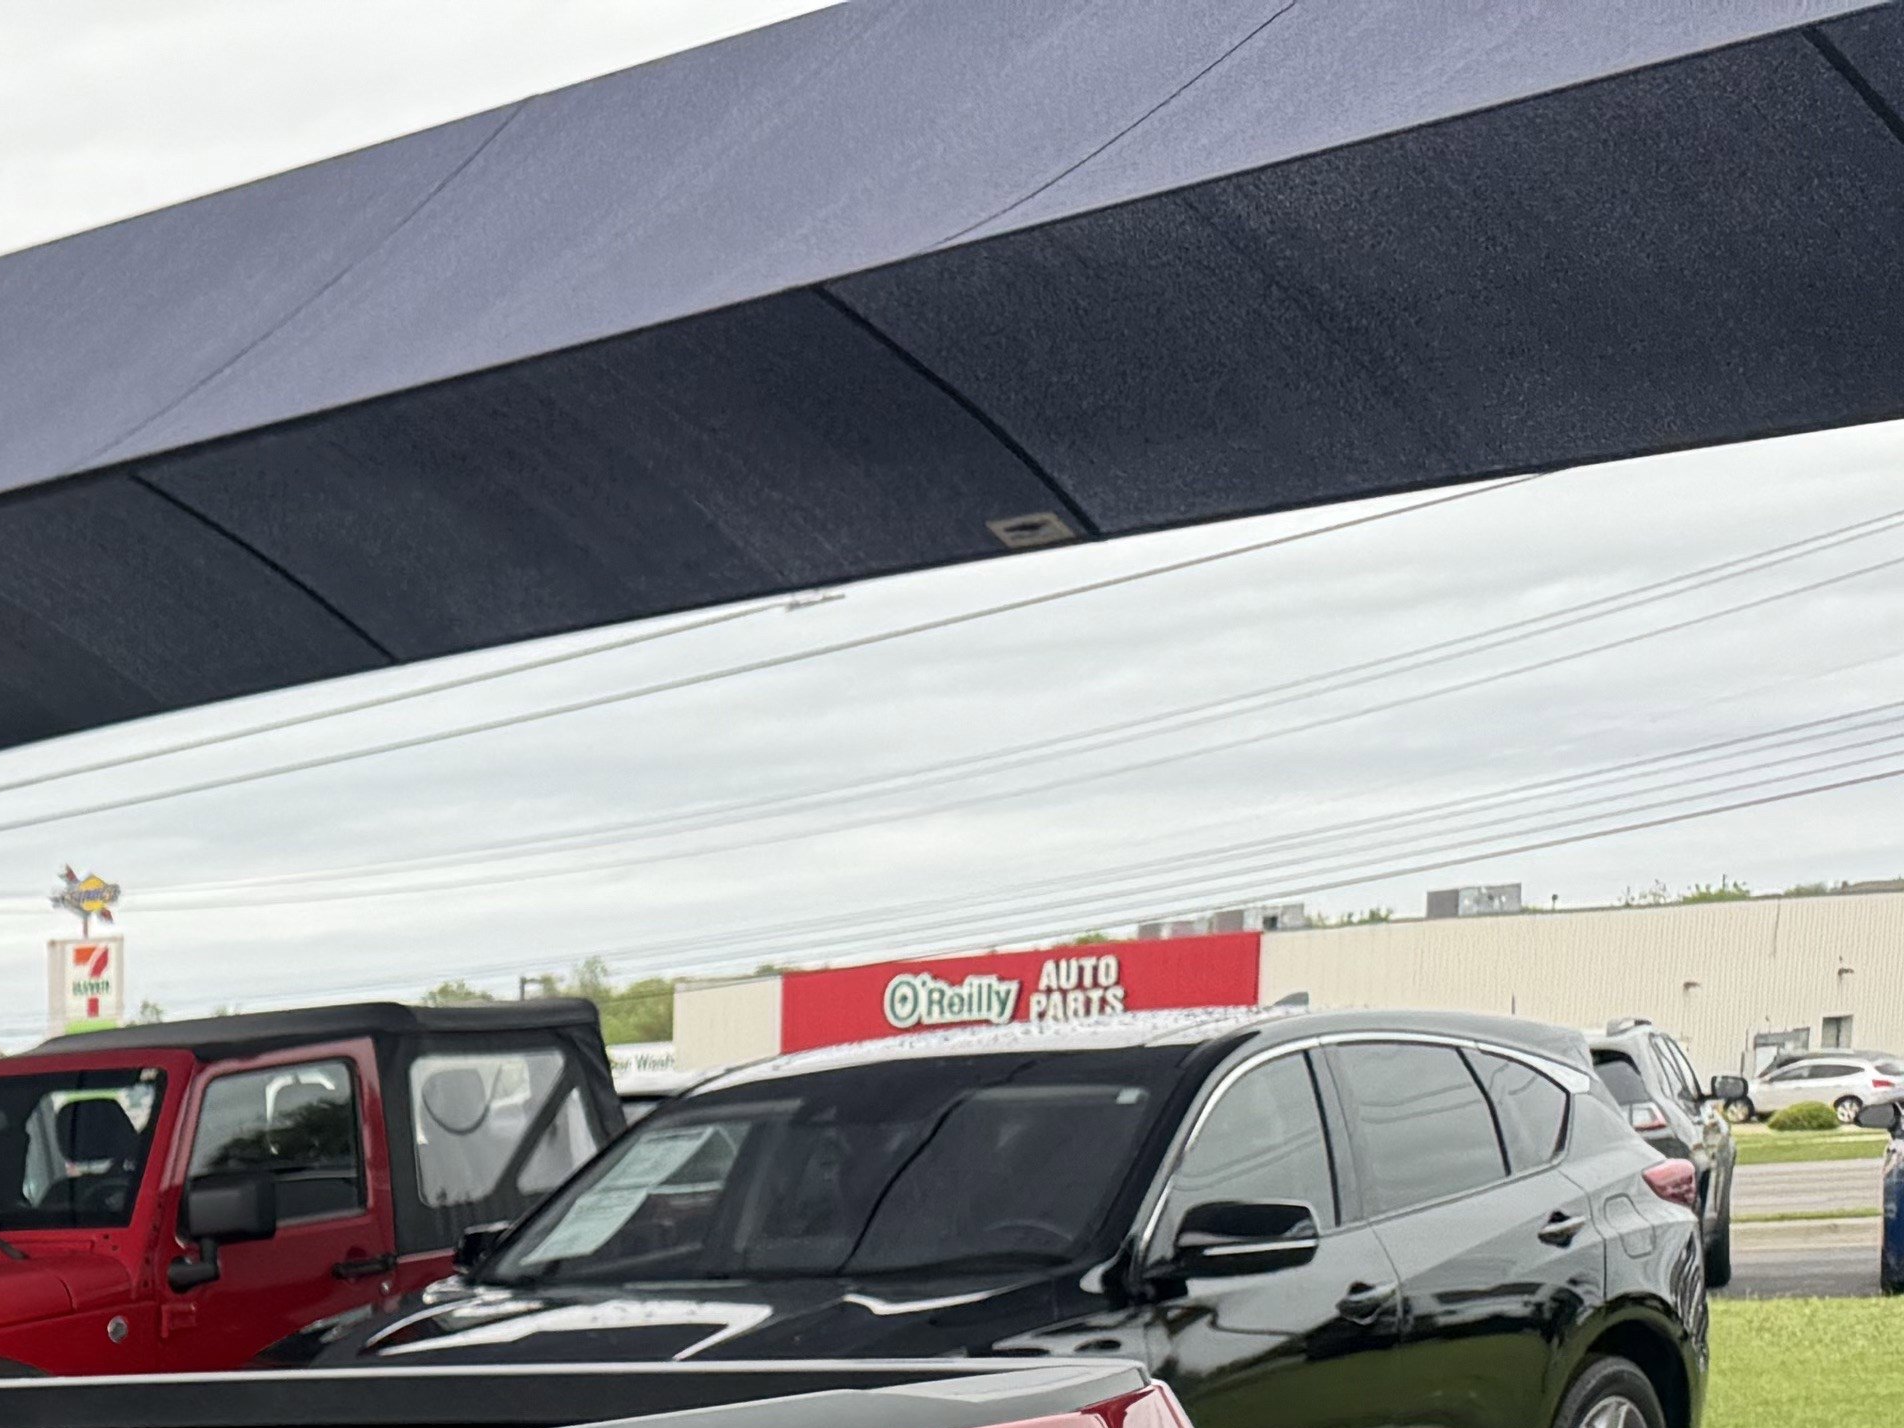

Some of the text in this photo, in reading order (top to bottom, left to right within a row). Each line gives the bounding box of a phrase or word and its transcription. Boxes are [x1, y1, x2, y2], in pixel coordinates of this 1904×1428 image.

[1038, 955, 1119, 990] AUTO
[887, 974, 1018, 1027] O'Reilly
[1030, 986, 1125, 1023] PARTS
